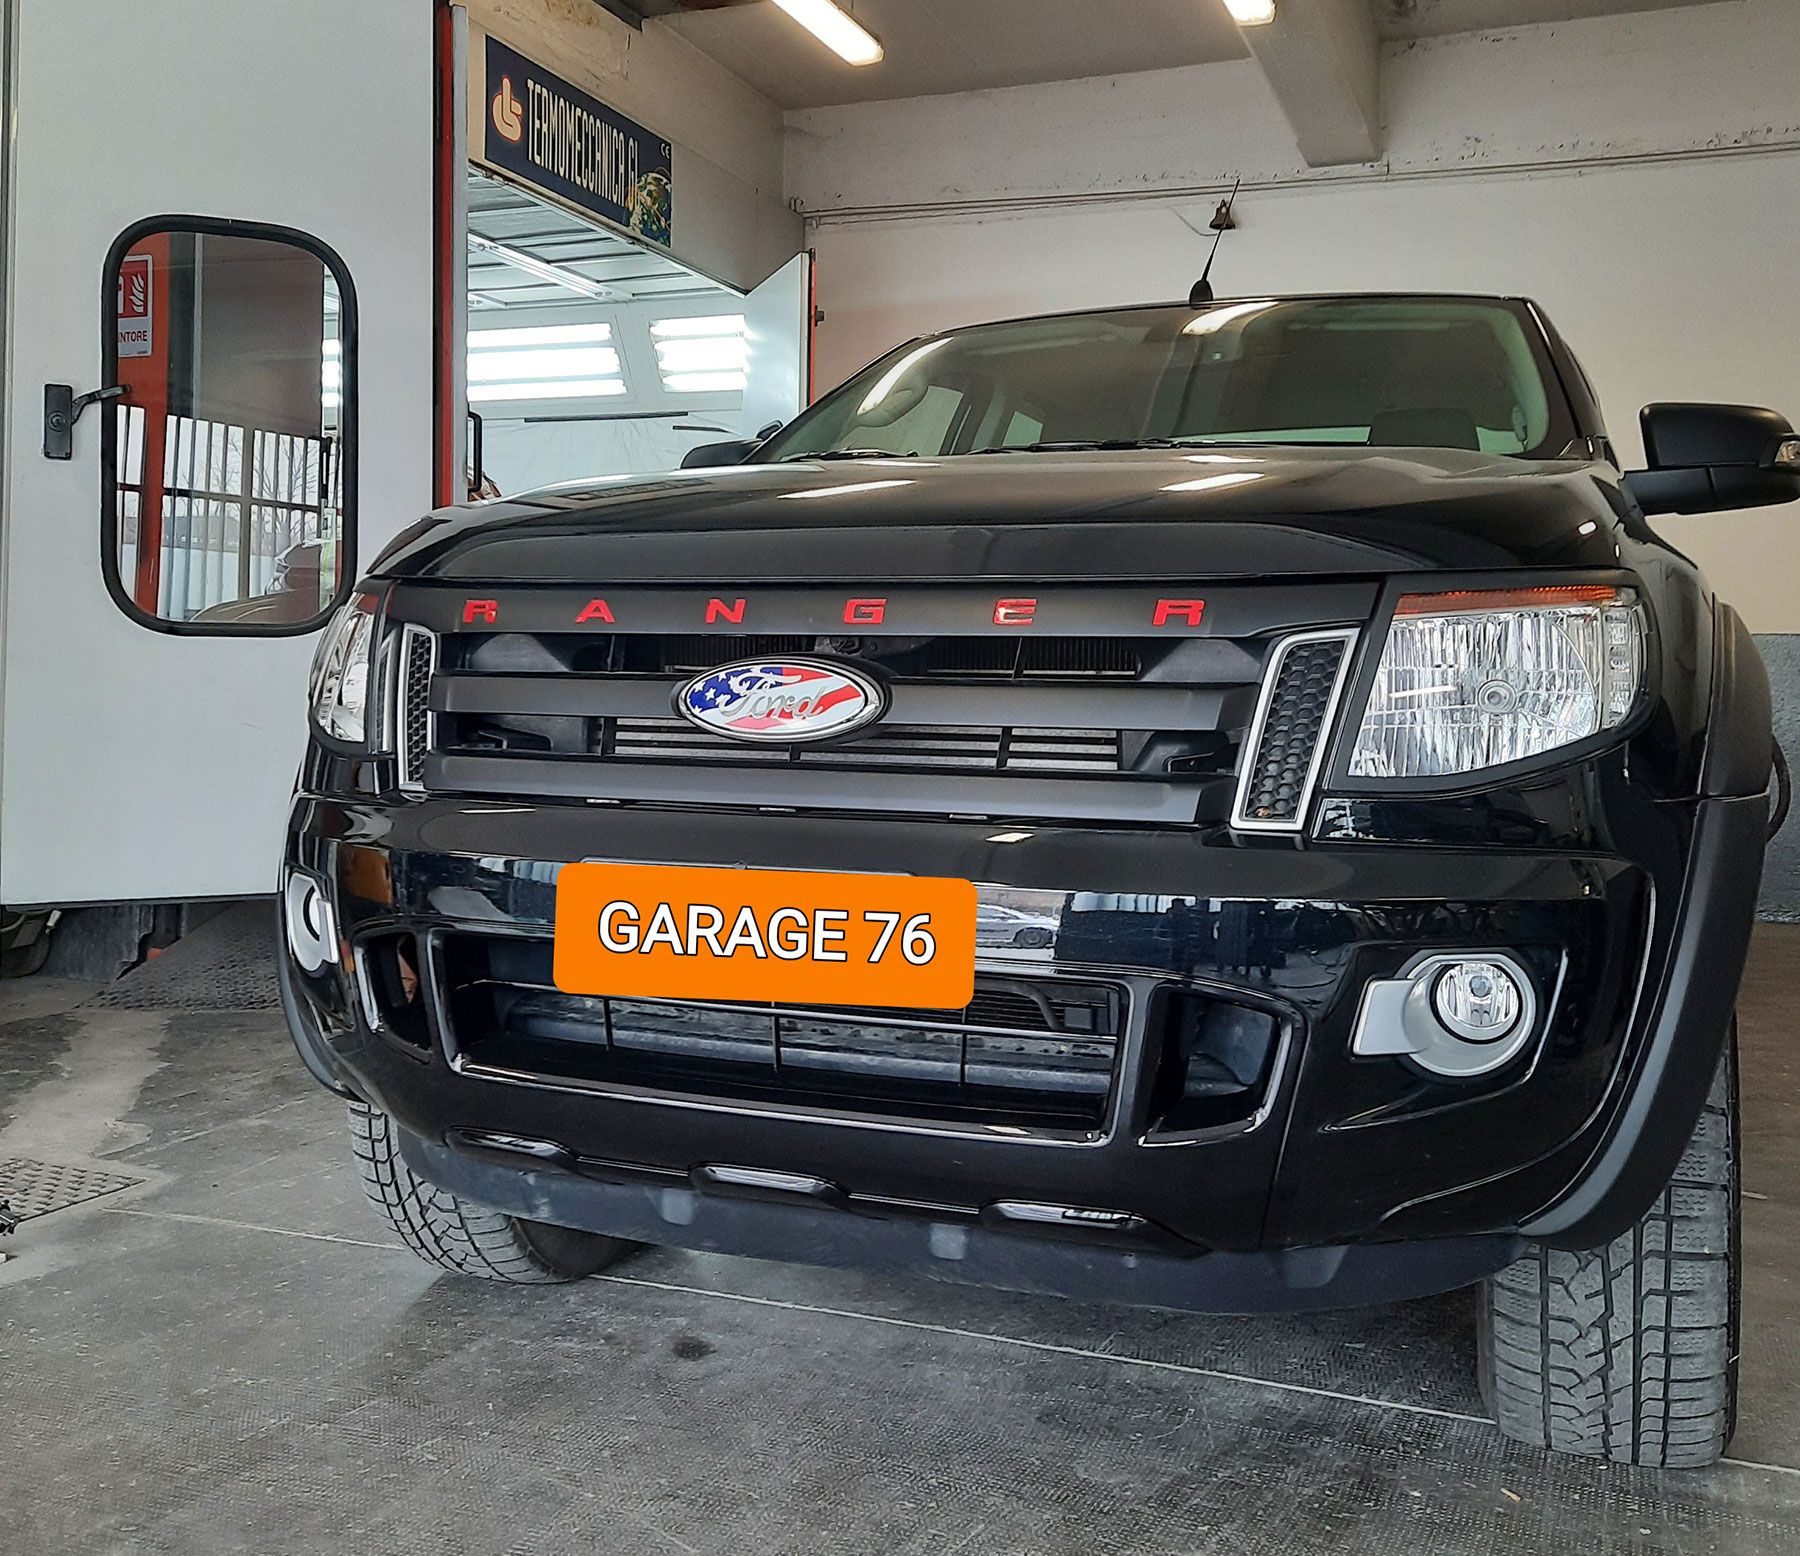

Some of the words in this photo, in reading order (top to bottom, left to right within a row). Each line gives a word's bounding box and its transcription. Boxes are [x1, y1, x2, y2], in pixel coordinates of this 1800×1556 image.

[527, 78, 625, 207] TERMOMECCANICA
[118, 330, 148, 343] NTORE
[462, 598, 1205, 626] RANGER
[717, 671, 826, 719] Ford
